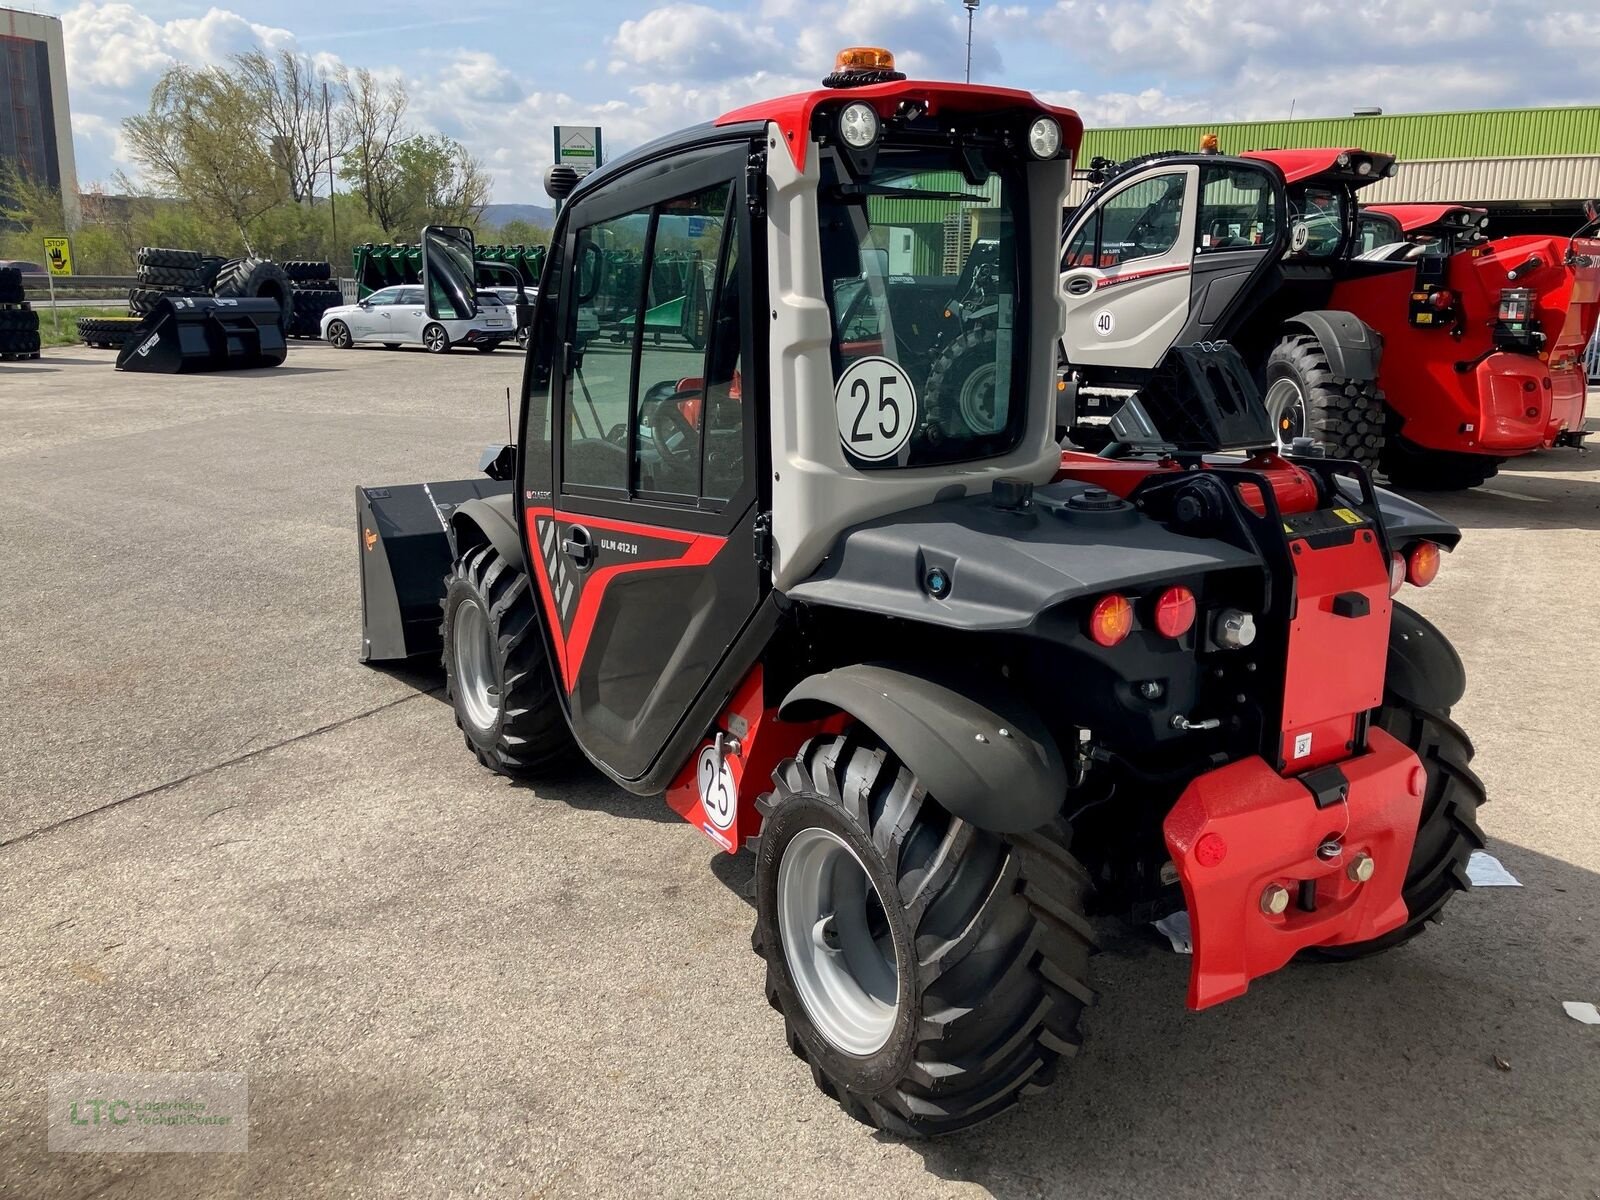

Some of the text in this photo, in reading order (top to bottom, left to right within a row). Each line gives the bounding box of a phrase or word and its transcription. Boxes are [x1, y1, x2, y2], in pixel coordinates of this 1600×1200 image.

[1295, 227, 1306, 246] 40
[1098, 315, 1110, 331] 40
[850, 376, 900, 443] 25
[600, 539, 638, 555] ULM 412 H
[705, 758, 728, 817] 25
